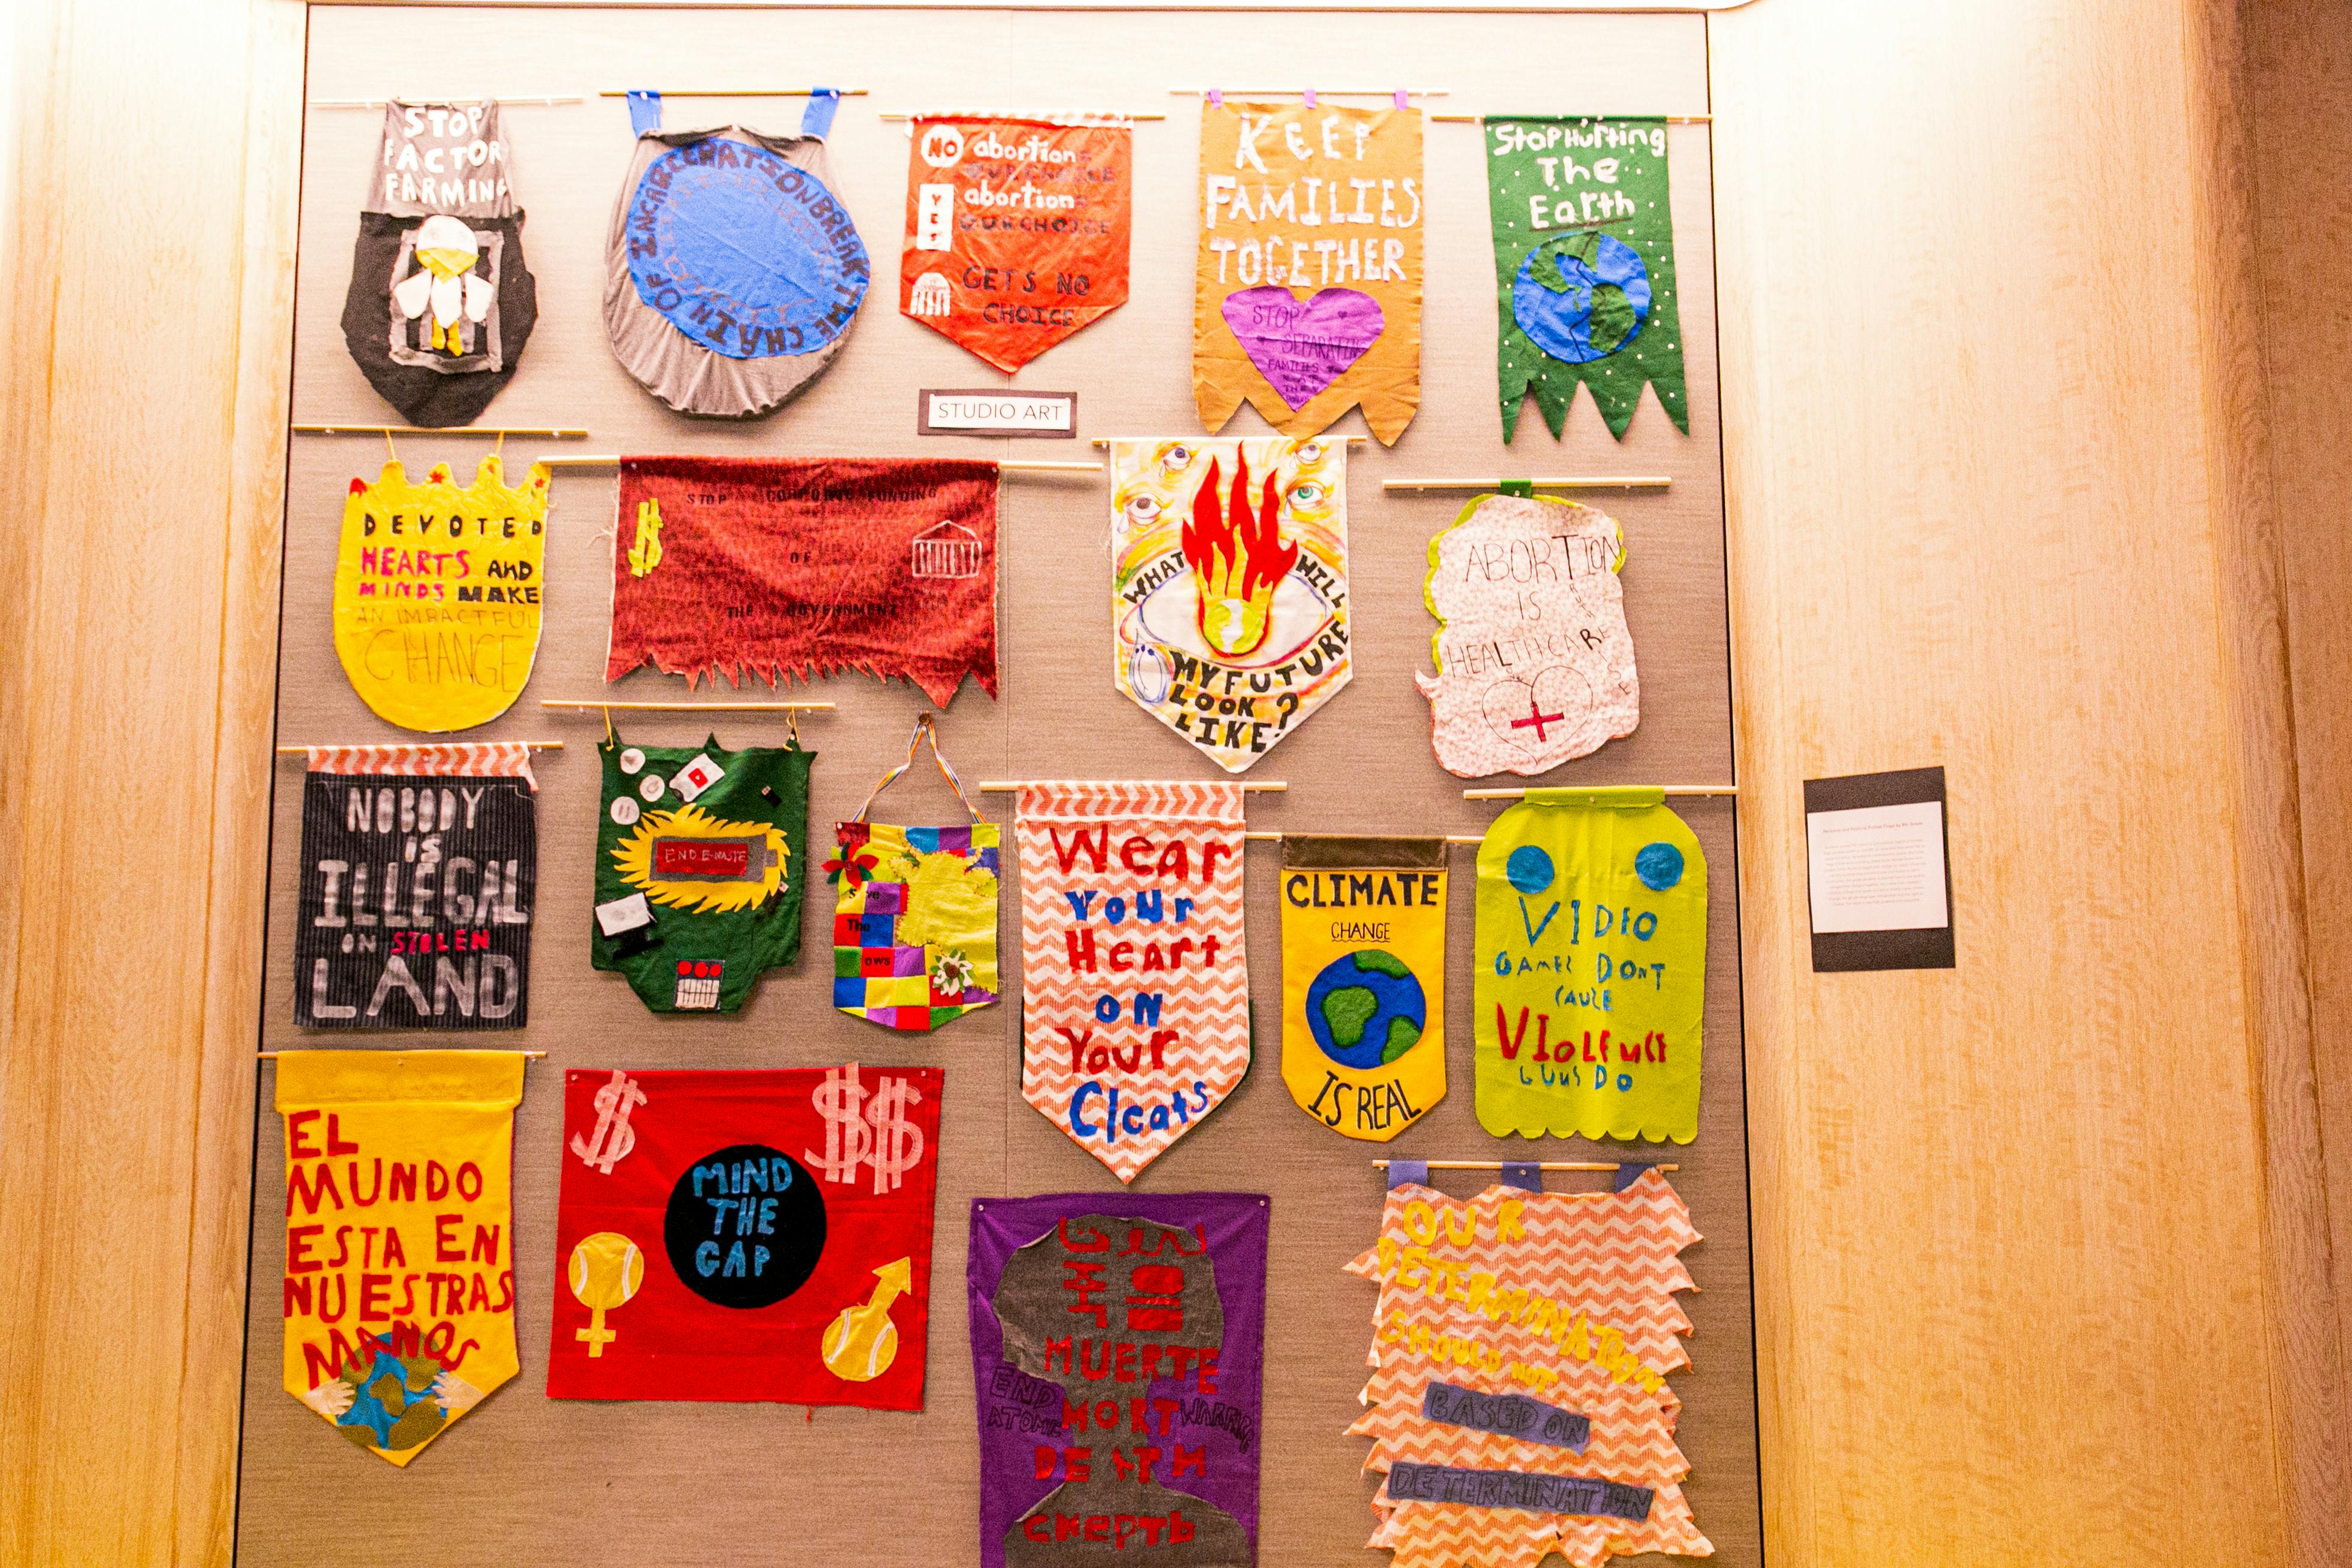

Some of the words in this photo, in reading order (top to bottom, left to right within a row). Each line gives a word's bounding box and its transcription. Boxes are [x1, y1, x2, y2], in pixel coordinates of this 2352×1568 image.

[404, 106, 483, 138] STOP
[1236, 113, 1370, 174] KEEP
[1493, 123, 1563, 156] Stop
[928, 138, 956, 158] NO
[385, 172, 507, 208] FARMING
[1537, 156, 1620, 187] The
[930, 194, 942, 241] YES
[1206, 174, 1421, 229] FAMILIES
[1528, 189, 1636, 229] Earth
[809, 198, 870, 277] BREAK
[1210, 235, 1407, 286] TOGETHER
[647, 273, 681, 311] OF
[962, 266, 1037, 293] GETS
[1057, 272, 1089, 296] NO
[690, 304, 803, 355] CHAIN
[815, 285, 861, 341] THE
[983, 303, 1074, 327] CHOICE
[939, 402, 1015, 420] STUDIO
[1024, 404, 1062, 420] ART
[364, 513, 542, 538] DEVOTED
[361, 546, 470, 579] HEARTS
[488, 560, 532, 581] AND
[1123, 550, 1186, 604] WHAT
[1297, 554, 1346, 609] WILL
[1466, 534, 1624, 584] ABORTION
[356, 608, 384, 624] AN
[359, 582, 445, 601] MINDS
[458, 586, 539, 604] MAKE
[1518, 591, 1540, 620] IS
[365, 629, 524, 693] CHANGE
[1169, 650, 1221, 689] MY
[1225, 619, 1349, 695] FUTURE
[1446, 623, 1611, 678] HEALTHCARE
[1169, 685, 1257, 718] LOOK
[347, 787, 484, 833] NOBODY
[405, 834, 441, 863] IS
[665, 848, 697, 862] END
[1050, 824, 1231, 883] Wear
[314, 856, 528, 928] ILLEGAL
[1287, 874, 1438, 908] CLIMATE
[341, 933, 376, 953] ON
[391, 930, 489, 954] STOLEN
[1331, 922, 1390, 940] CHANGE
[1519, 897, 1657, 947] VIDEO
[1065, 929, 1221, 973] Heart
[313, 954, 519, 1018] LAND
[1055, 1027, 1179, 1074] Your
[1308, 1070, 1352, 1127] IS
[1357, 1079, 1422, 1130] REAL
[1594, 1064, 1633, 1092] DO
[289, 1110, 358, 1159] EL
[286, 1158, 482, 1216] MUNDO
[692, 1157, 792, 1197] MIND
[707, 1197, 779, 1236] THE
[1403, 1200, 1526, 1246] OUR
[288, 1225, 405, 1274] ESTA
[436, 1215, 500, 1265] EN
[695, 1241, 770, 1278] GAP
[284, 1270, 513, 1323] NUESTRAS
[1377, 1236, 1665, 1395] DETERMINATION
[304, 1320, 479, 1390] MANOS
[1044, 1334, 1218, 1394] MUERTE
[1380, 1310, 1501, 1373] SHOULD
[1512, 1361, 1558, 1394] NOT
[989, 1366, 1057, 1409] END
[1061, 1398, 1179, 1436] MORT
[1429, 1390, 1538, 1431] BASED
[1544, 1414, 1588, 1443] ON
[1034, 1445, 1206, 1484] DEATH
[1390, 1464, 1653, 1519] DETERMINATION
